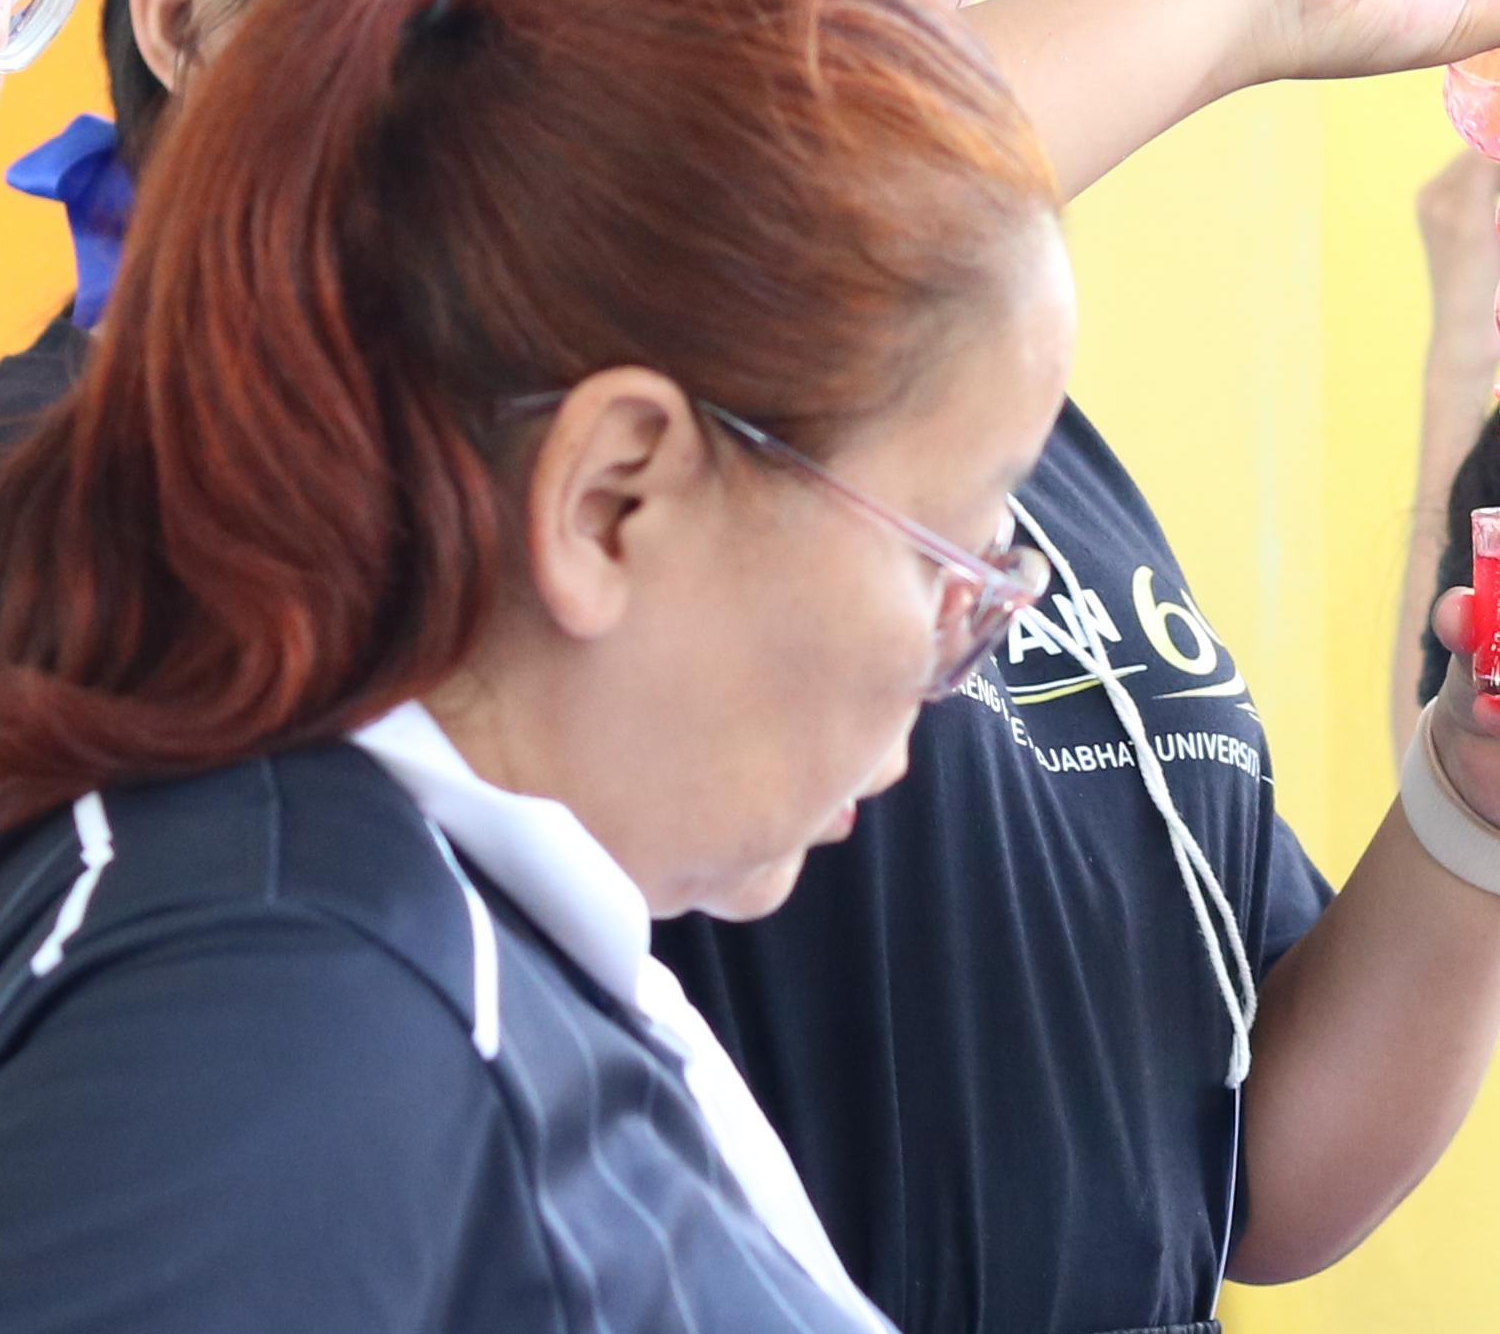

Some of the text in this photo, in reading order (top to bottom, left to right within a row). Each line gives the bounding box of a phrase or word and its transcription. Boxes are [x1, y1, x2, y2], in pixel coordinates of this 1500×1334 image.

[1132, 565, 1225, 676] 6
[1029, 737, 1137, 773] AJABHA
[1154, 731, 1274, 785] UNIVERSIT
